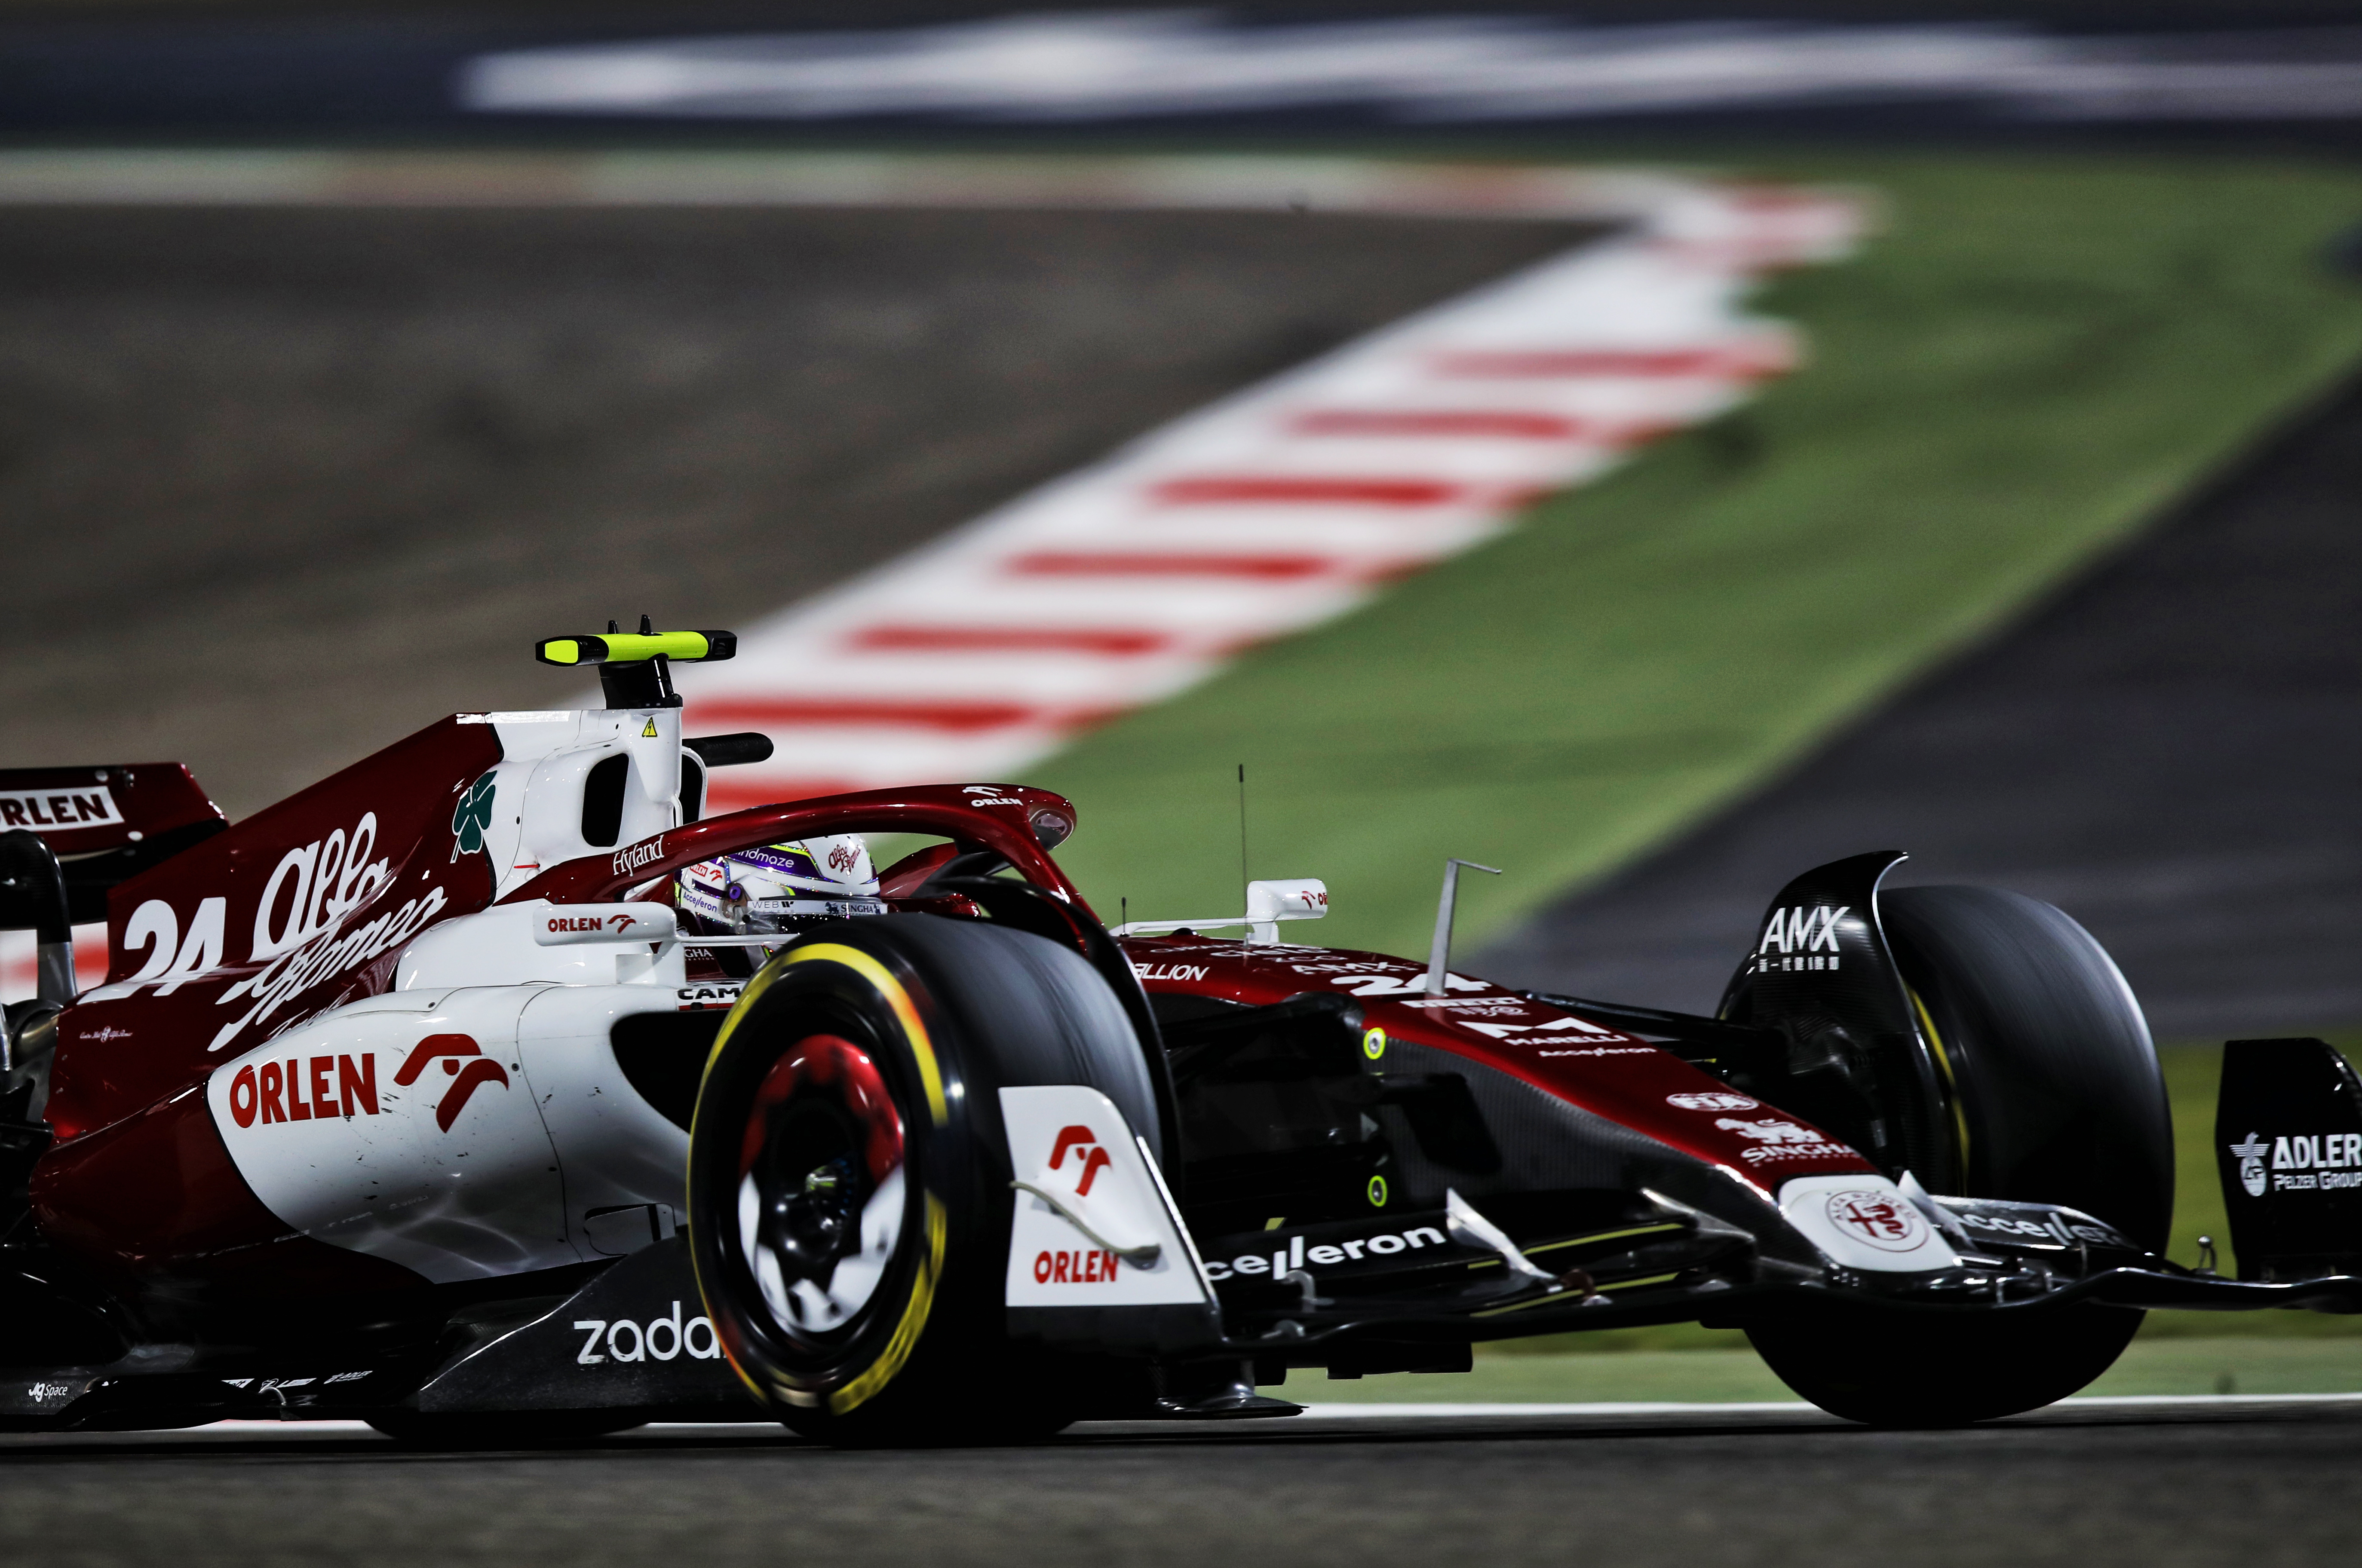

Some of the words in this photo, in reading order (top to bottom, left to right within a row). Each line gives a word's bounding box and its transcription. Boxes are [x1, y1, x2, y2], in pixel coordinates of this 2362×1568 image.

[0, 794, 109, 825] RLEN
[971, 798, 1024, 807] ORLEN
[613, 834, 665, 877] Hyland
[736, 848, 794, 868] indmaze
[247, 812, 389, 963] Alfa
[683, 891, 717, 913] Accelleron
[841, 903, 873, 913] SNGHA
[548, 917, 602, 933] ORLEN
[1759, 905, 1850, 955] AMX
[77, 897, 226, 1005] 24
[685, 949, 712, 958] GHA
[207, 886, 448, 1052] Romeo
[1133, 963, 1210, 981] ELLION
[1330, 973, 1492, 996] 24
[678, 988, 742, 1000] CAM
[1504, 1035, 1630, 1045] MARELLI
[230, 1053, 380, 1128] ORLEN
[2272, 1133, 2362, 1169] ADLER
[1034, 1250, 1120, 1284] ORLEN
[1204, 1227, 1446, 1281] celleron
[574, 1301, 728, 1365] zada
